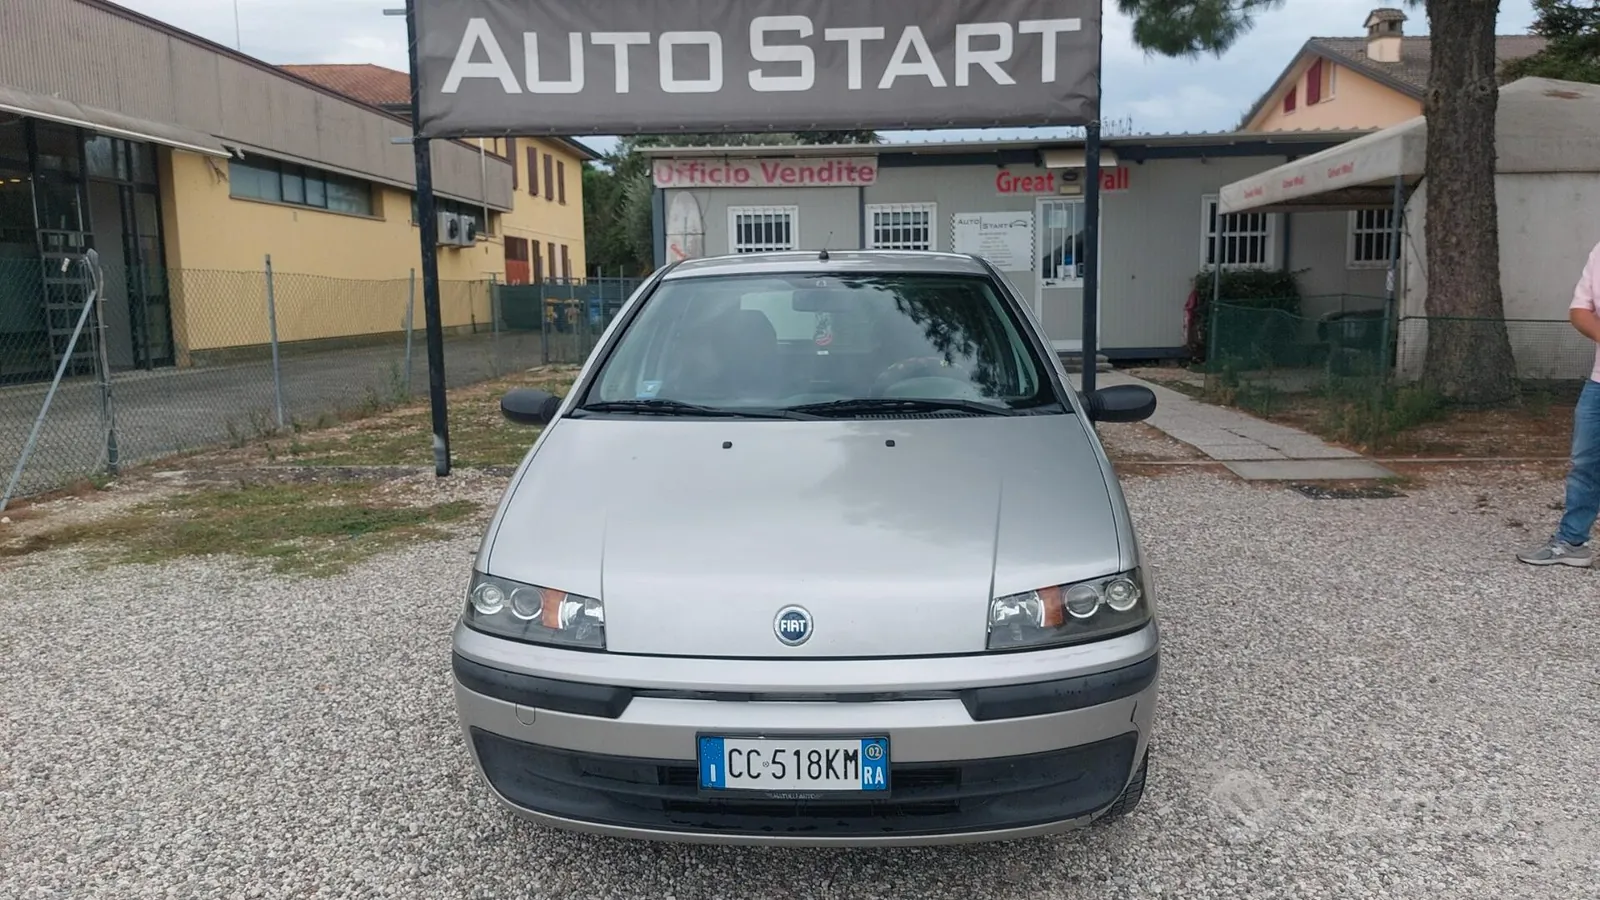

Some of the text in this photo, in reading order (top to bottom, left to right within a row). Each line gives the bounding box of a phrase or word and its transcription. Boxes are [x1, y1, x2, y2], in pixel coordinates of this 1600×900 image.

[441, 15, 1082, 94] AUTO START
[656, 161, 875, 184] Ufficio Vendite
[995, 167, 1129, 193] Great all
[781, 620, 805, 632] FIAT
[868, 747, 881, 757] 02
[864, 766, 885, 785] RA
